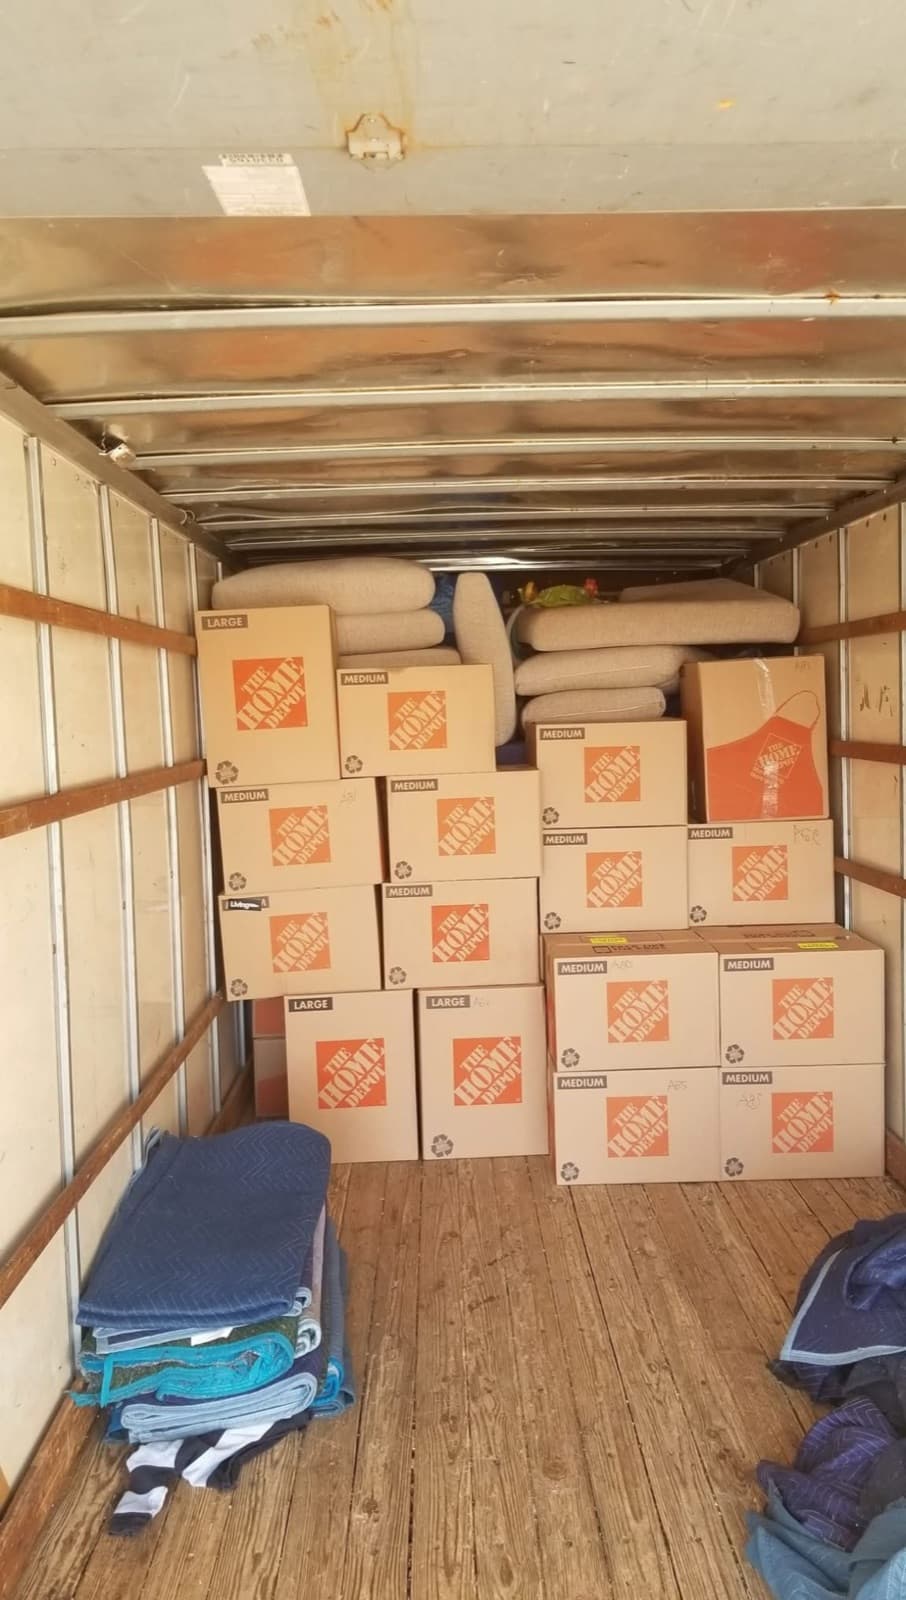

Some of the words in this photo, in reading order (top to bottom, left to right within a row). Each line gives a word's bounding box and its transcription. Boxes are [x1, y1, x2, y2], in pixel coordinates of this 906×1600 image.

[207, 616, 244, 628] LARGE
[237, 658, 305, 731] HOME
[241, 666, 270, 694] THE
[343, 673, 386, 684] MEDIUM
[265, 683, 306, 729] DEPOT
[390, 692, 446, 751] HOME
[394, 698, 418, 721] THE
[413, 712, 447, 750] DEPOT
[543, 729, 583, 739] MEDIUM
[585, 747, 641, 803] HOME
[590, 752, 613, 775] THE
[224, 791, 266, 802] MEDIUM
[394, 780, 436, 791] MEDIUM
[607, 767, 641, 802] DEPOT
[276, 813, 300, 837] THE
[439, 798, 495, 856] HOME
[443, 804, 467, 827] THE
[691, 828, 730, 838] MEDIUM
[273, 807, 329, 866] HOME
[296, 827, 330, 865] DEPOT
[462, 818, 496, 856] DEPOT
[546, 834, 585, 845] MEDIUM
[588, 852, 642, 908] HOME
[592, 858, 615, 880] THE
[733, 846, 788, 902] HOME
[737, 852, 761, 874] THE
[388, 886, 430, 896] MEDIUM
[609, 872, 642, 908] DEPOT
[755, 866, 788, 901] DEPOT
[277, 921, 300, 944] THE
[433, 905, 489, 962] HOME
[437, 911, 461, 933] THE
[273, 913, 329, 973] HOME
[297, 934, 330, 971] DEPOT
[456, 925, 489, 962] DEPOT
[560, 963, 604, 973] MEDIUM
[727, 960, 770, 969] MEDIUM
[293, 1000, 328, 1010] LARGE
[432, 997, 465, 1008] LARGE
[608, 981, 668, 1043] HOME
[613, 988, 638, 1012] THE
[773, 978, 834, 1040] HOME
[778, 984, 804, 1009] THE
[633, 1003, 669, 1042] DEPOT
[798, 1000, 834, 1039] DEPOT
[318, 1039, 385, 1110] HOME
[323, 1047, 351, 1074] THE
[455, 1037, 522, 1106] HOME
[460, 1044, 488, 1071] THE
[346, 1063, 386, 1108] DEPOT
[482, 1061, 522, 1105] DEPOT
[560, 1078, 604, 1088] MEDIUM
[726, 1073, 769, 1083] MEDIUM
[608, 1097, 668, 1158] HOME
[613, 1103, 638, 1127] THE
[772, 1093, 833, 1154] HOME
[777, 1099, 803, 1123] THE
[632, 1118, 669, 1157] DEPOT
[797, 1114, 834, 1153] DEPOT
